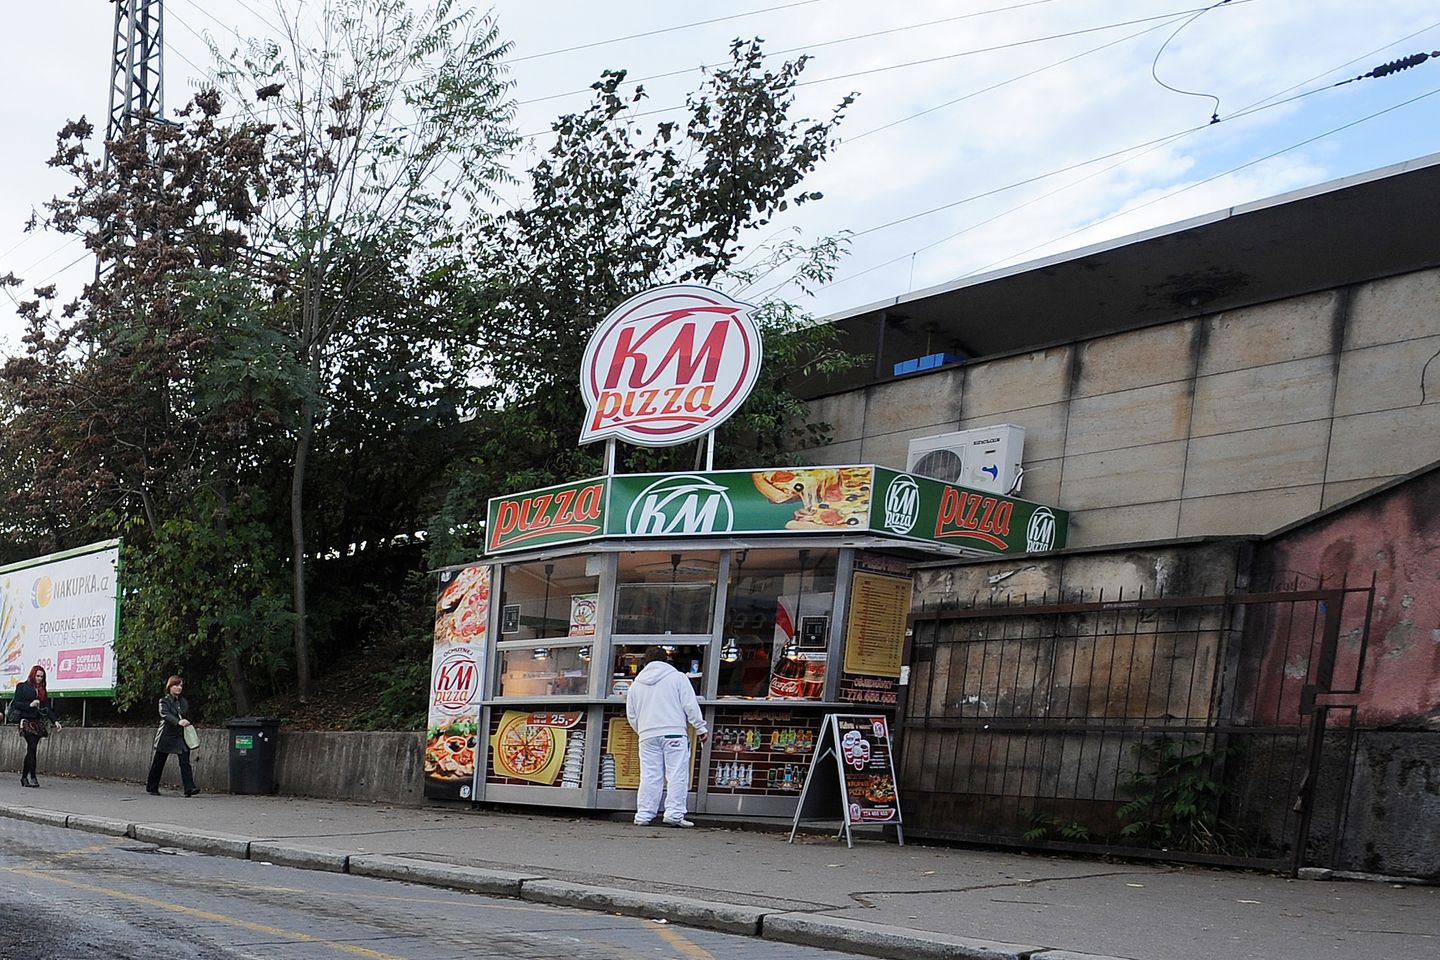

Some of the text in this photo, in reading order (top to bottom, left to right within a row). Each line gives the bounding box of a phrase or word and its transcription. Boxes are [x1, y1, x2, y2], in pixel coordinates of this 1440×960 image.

[604, 307, 741, 389] KM
[591, 385, 714, 431] pizza
[634, 484, 729, 534] KM
[888, 481, 918, 516] KM
[935, 485, 1014, 538] pizza
[489, 484, 604, 549] pizza
[885, 511, 912, 529] pizza
[1030, 513, 1055, 544] KM
[53, 574, 109, 599] NAKUPKA.cz
[38, 629, 69, 648] SENCOR
[89, 627, 106, 642] 436
[40, 613, 107, 633] PONORNÉ MIXÉRY
[437, 660, 476, 690] KM
[434, 691, 469, 706] pizza
